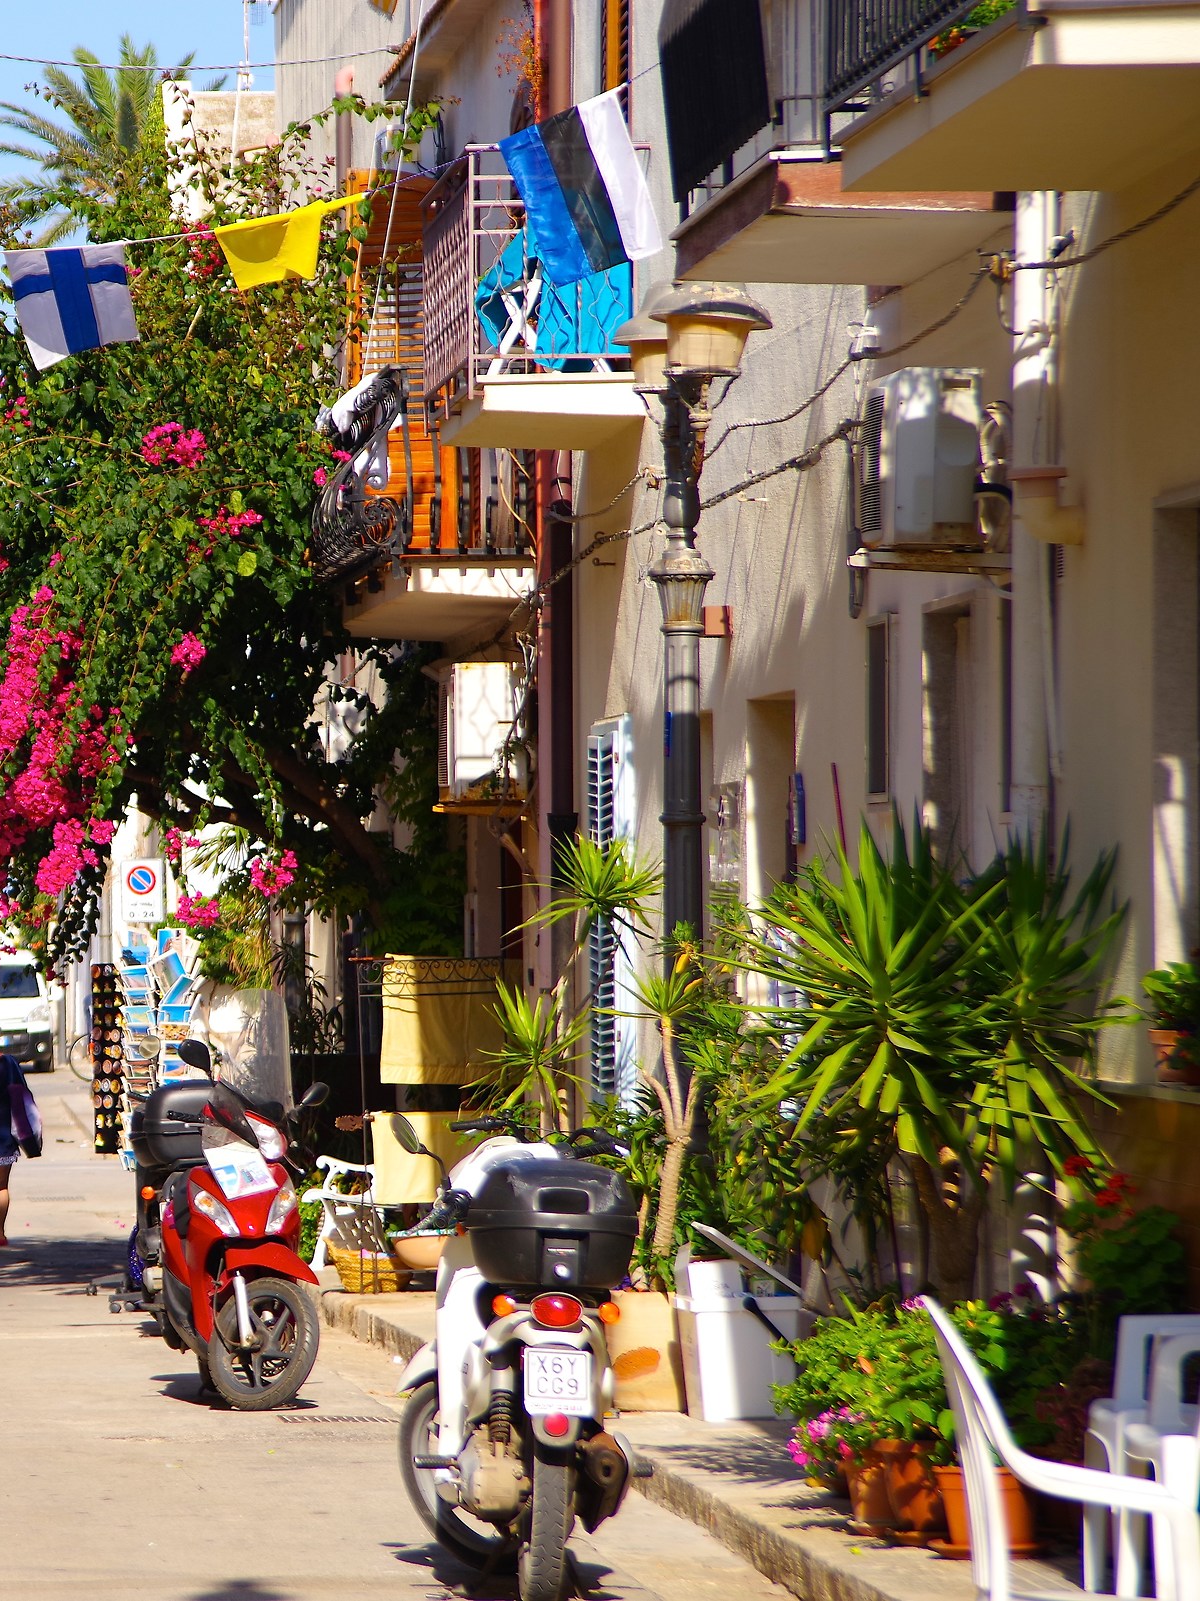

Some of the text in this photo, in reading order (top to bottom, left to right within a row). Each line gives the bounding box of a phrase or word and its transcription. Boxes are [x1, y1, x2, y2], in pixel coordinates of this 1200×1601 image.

[129, 911, 135, 919] 0
[143, 911, 155, 919] 24
[536, 1355, 577, 1376] X6Y
[537, 1376, 579, 1396] CG9
